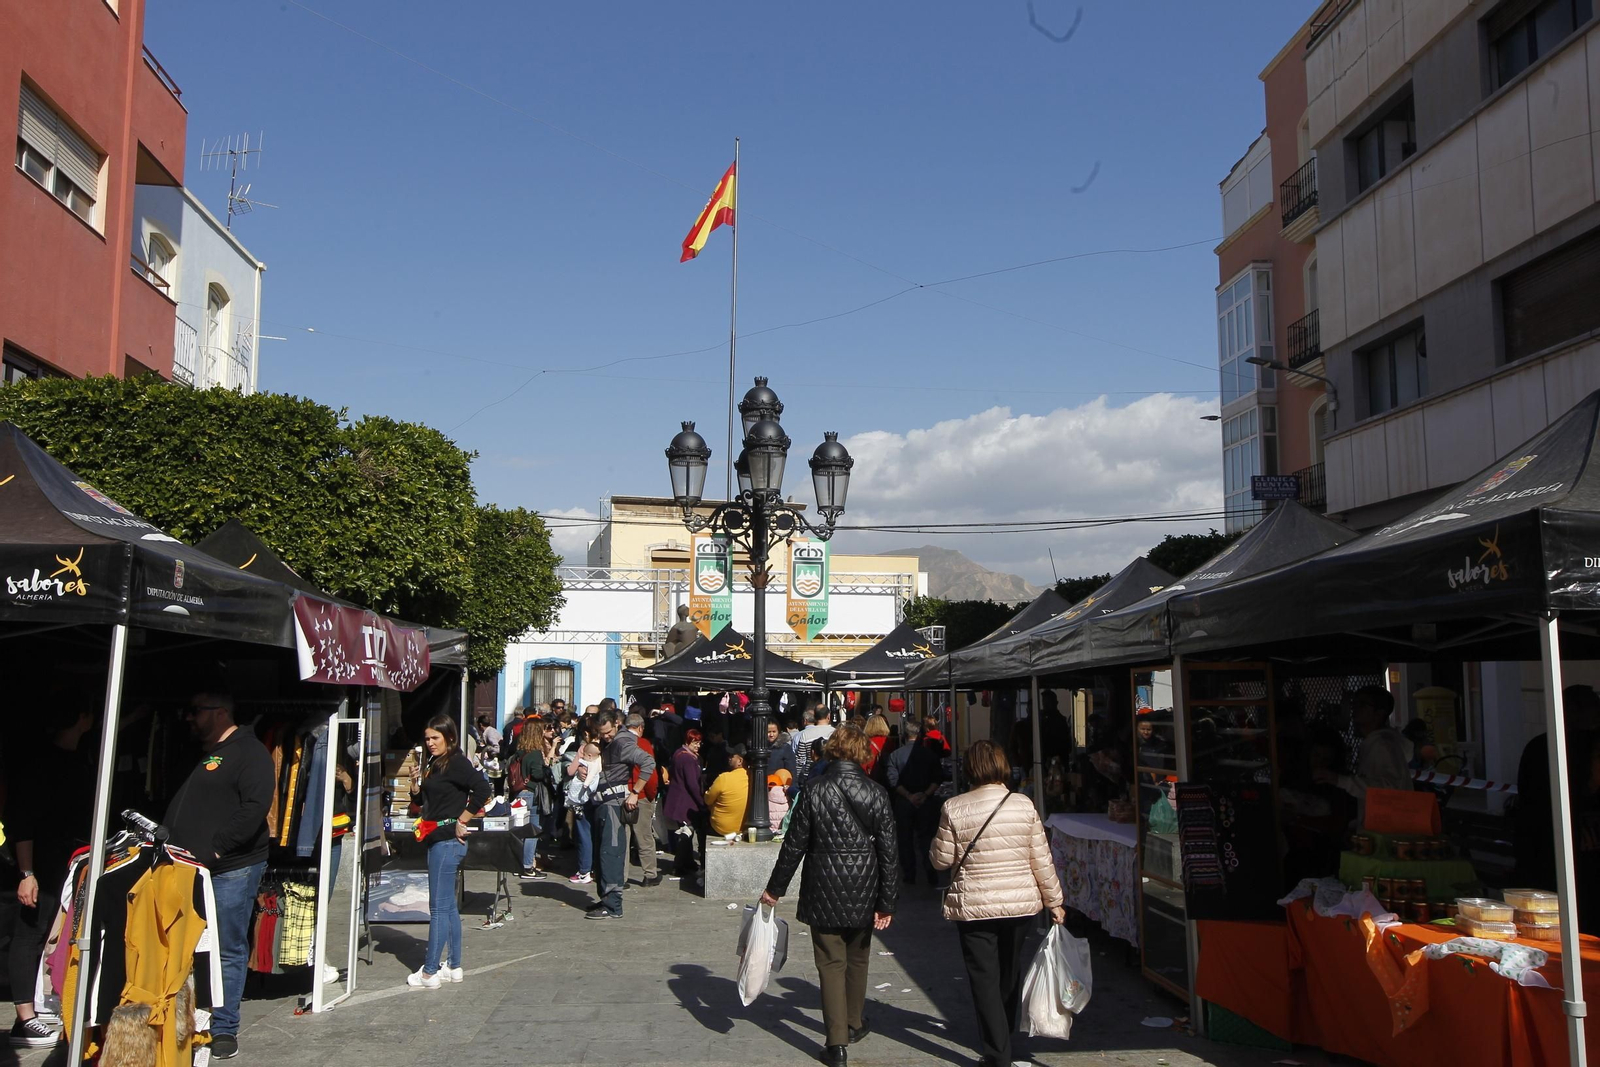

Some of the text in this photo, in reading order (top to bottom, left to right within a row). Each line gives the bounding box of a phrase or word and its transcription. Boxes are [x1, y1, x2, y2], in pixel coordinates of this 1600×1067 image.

[1584, 557, 1600, 568] DI
[1447, 556, 1509, 588] sabores
[6, 568, 91, 596] sabores
[690, 610, 731, 624] Gádor
[788, 613, 828, 628] Gádor
[695, 651, 752, 664] sabores
